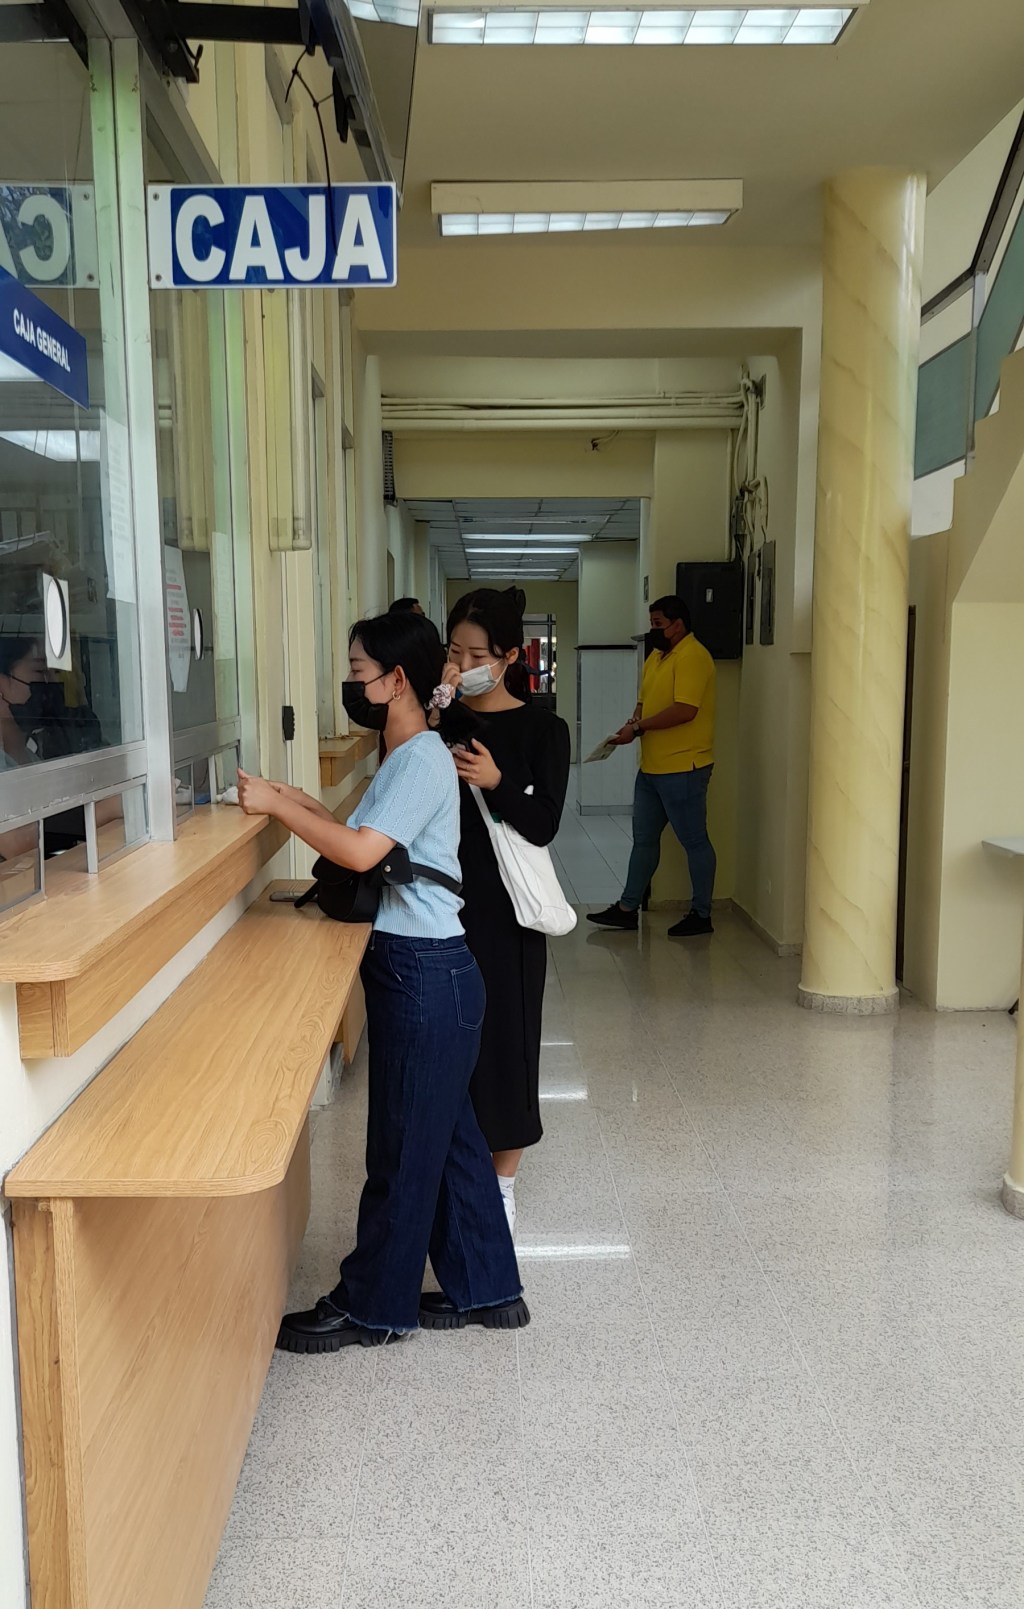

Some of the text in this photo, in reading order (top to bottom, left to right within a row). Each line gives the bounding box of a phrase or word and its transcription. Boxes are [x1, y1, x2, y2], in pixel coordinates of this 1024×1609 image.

[175, 194, 388, 282] CAJA
[13, 307, 71, 373] CAJA GENERAL
